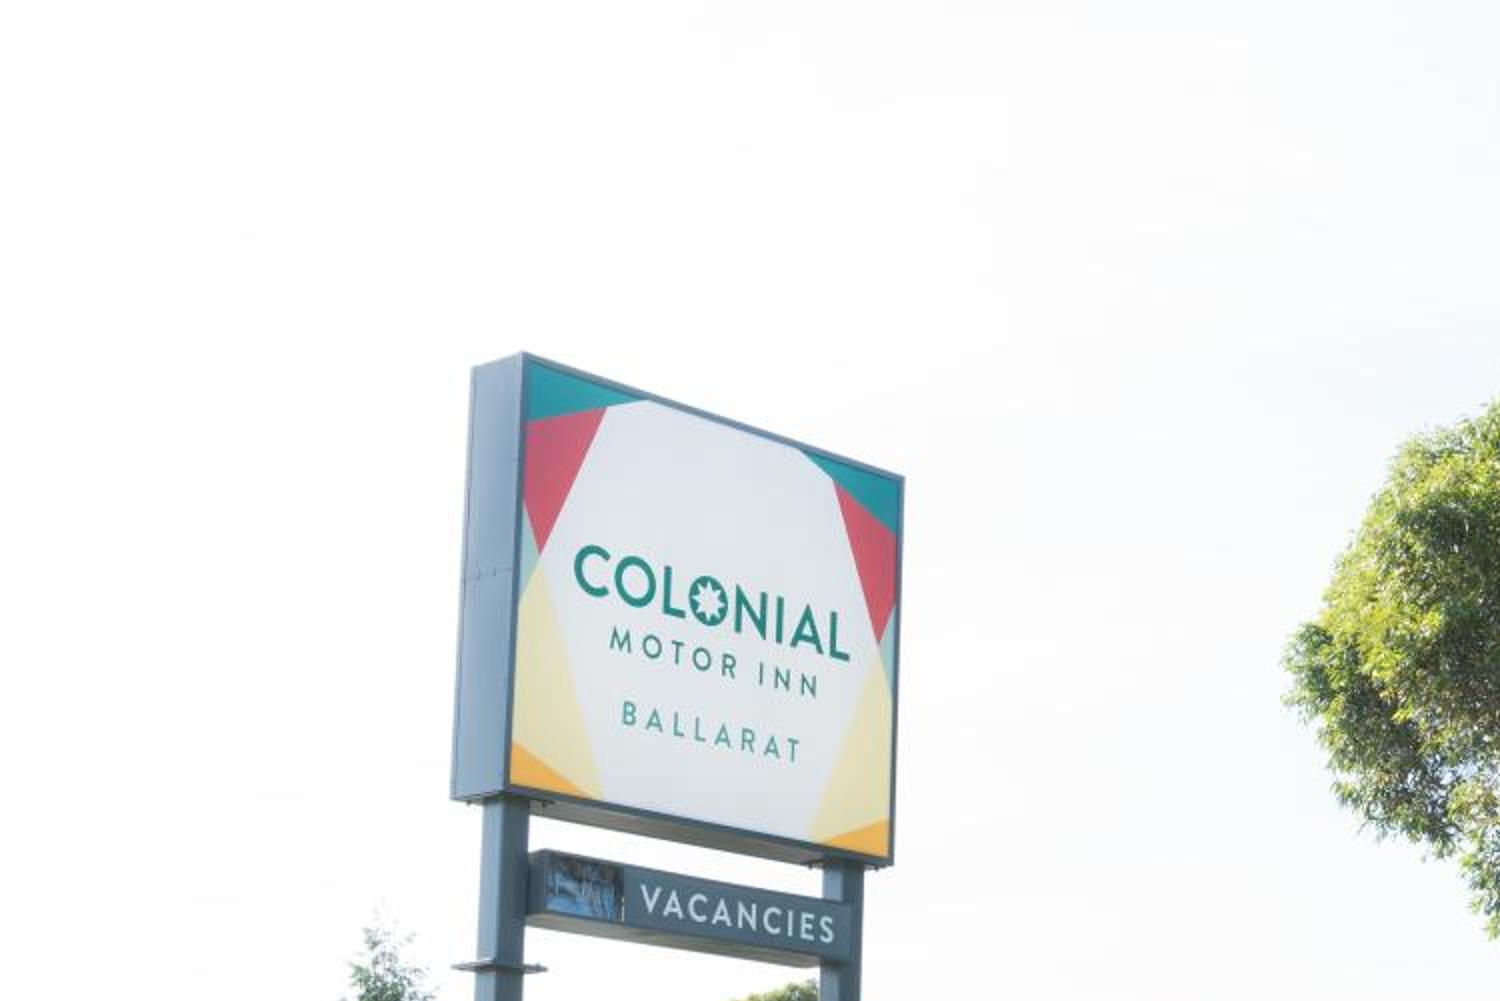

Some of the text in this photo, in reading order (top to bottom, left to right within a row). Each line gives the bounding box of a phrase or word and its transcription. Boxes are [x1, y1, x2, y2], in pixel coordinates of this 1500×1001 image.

[573, 544, 850, 661] COLONIAL
[609, 626, 817, 698] MOTOR INN
[622, 701, 800, 762] BALLARAT
[640, 883, 835, 943] VACANCIES
